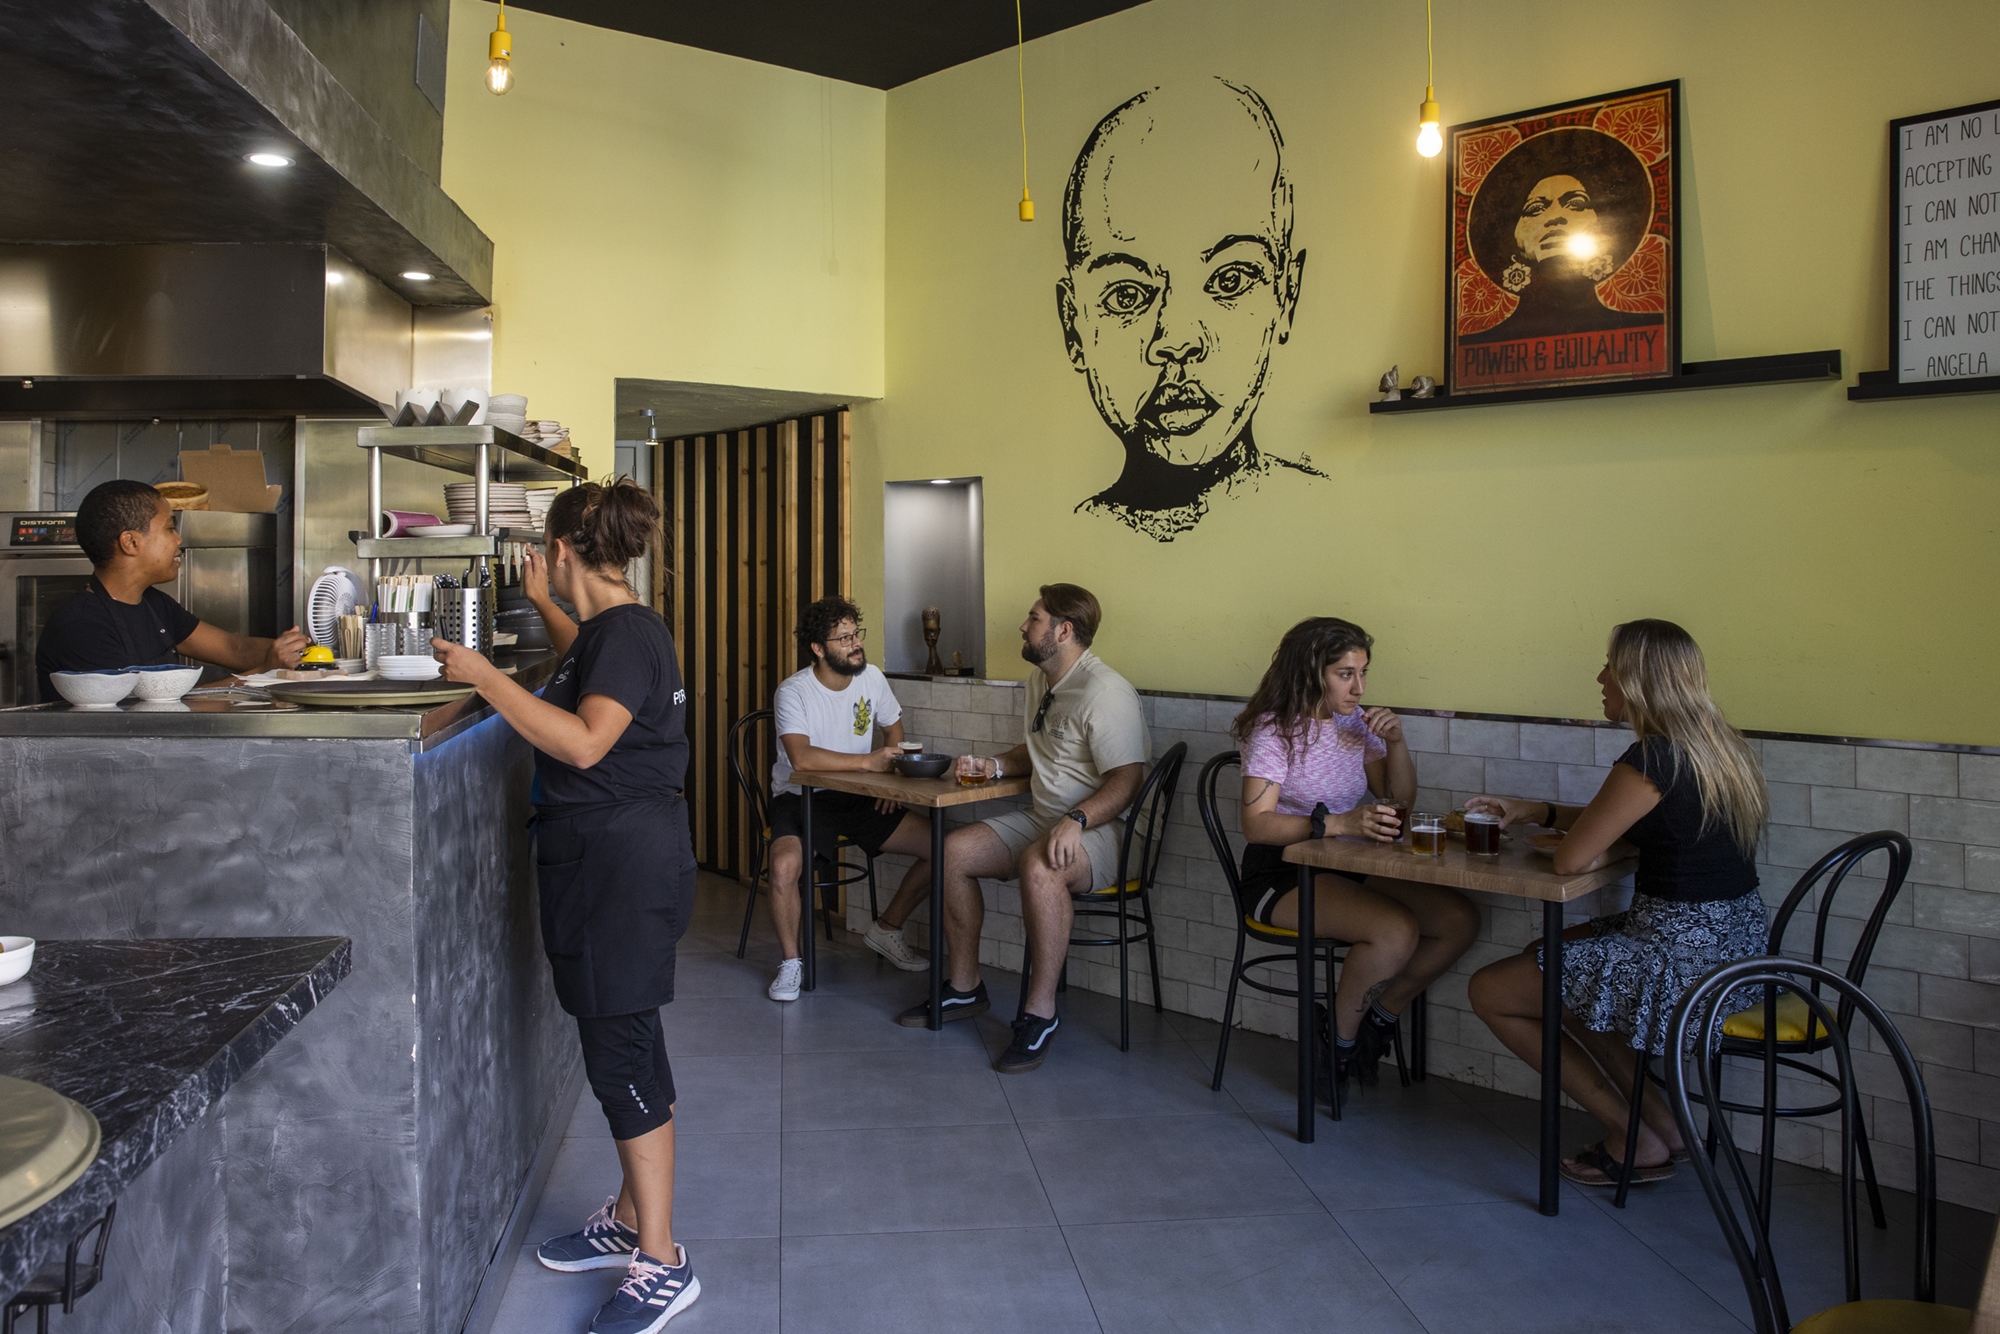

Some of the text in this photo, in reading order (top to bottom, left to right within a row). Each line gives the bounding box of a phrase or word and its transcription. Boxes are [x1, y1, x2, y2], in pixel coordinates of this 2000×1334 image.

[1905, 129, 1913, 150] I
[1925, 123, 1948, 147] AM
[1961, 117, 1981, 140] NO
[1456, 108, 1668, 263] POWER TO THE PEOPLE
[1905, 153, 1992, 188] ACCEPTING
[1904, 192, 2000, 226] I CAN NOT
[1904, 243, 1912, 264] I
[1924, 238, 1948, 261] AM
[1904, 277, 1935, 301] THE
[1903, 311, 2000, 341] I CAN NOT
[1463, 330, 1658, 377] POWER & EQUALITY
[1926, 352, 1988, 378] ANGELA
